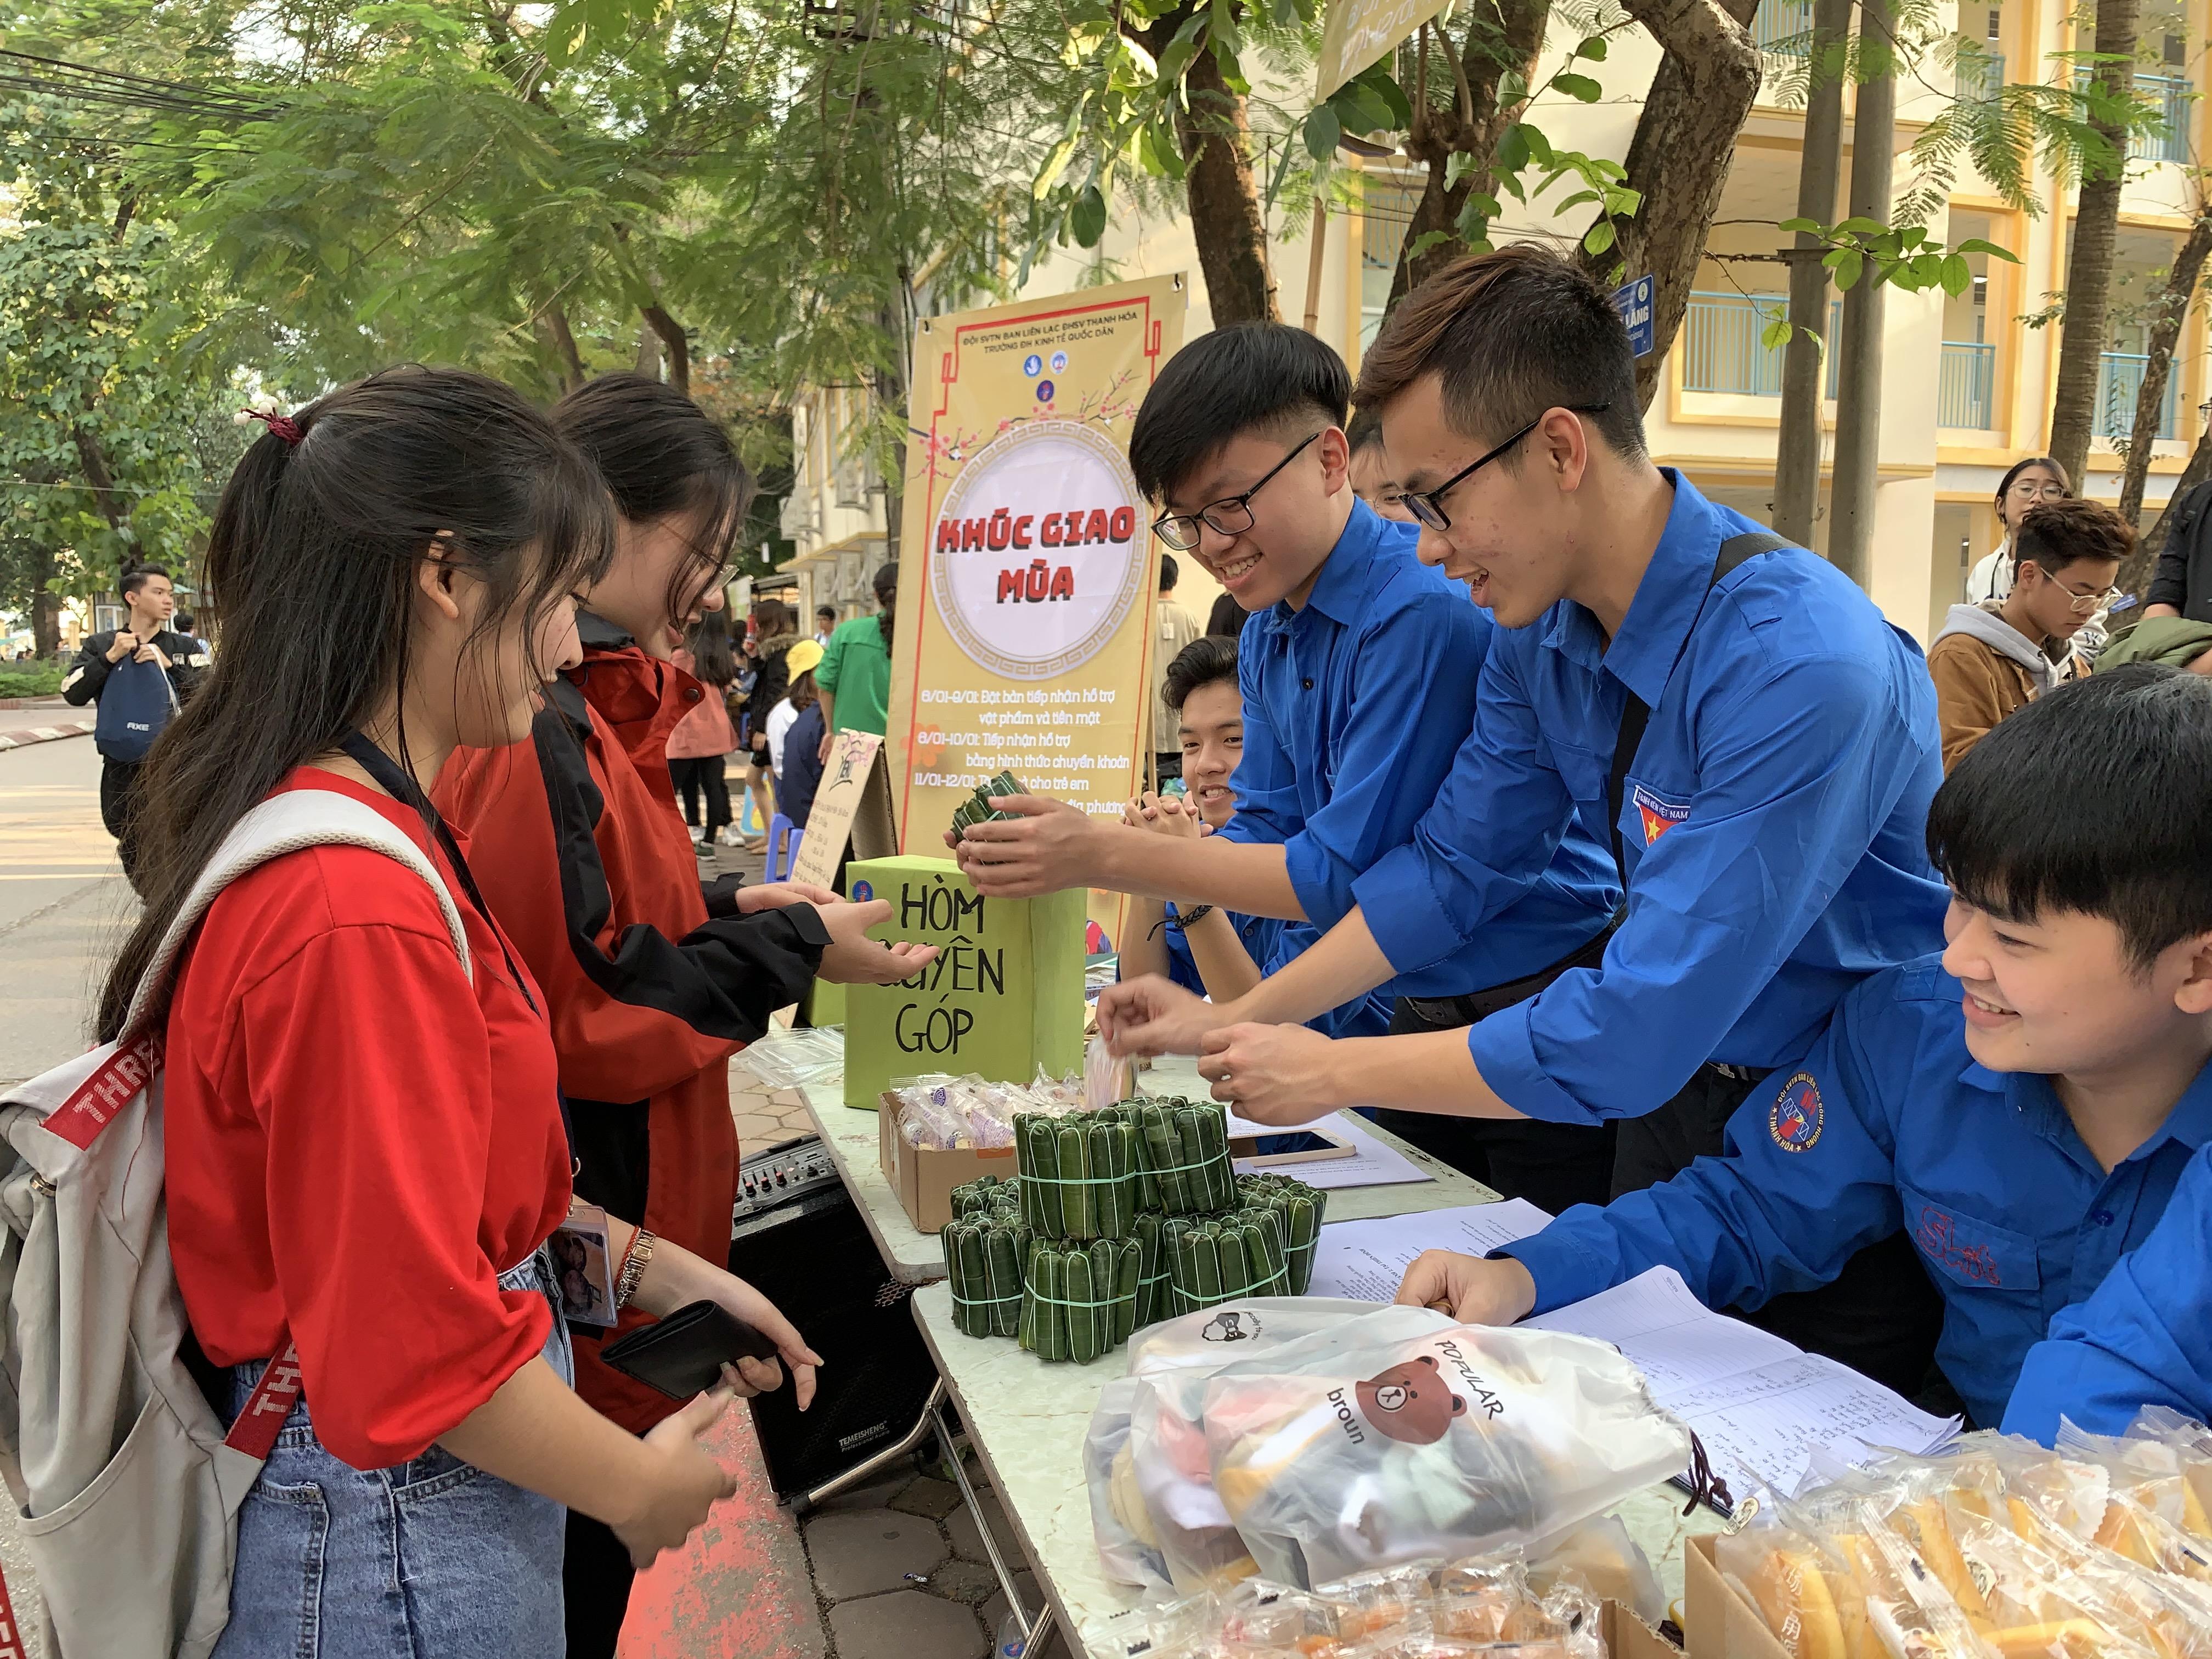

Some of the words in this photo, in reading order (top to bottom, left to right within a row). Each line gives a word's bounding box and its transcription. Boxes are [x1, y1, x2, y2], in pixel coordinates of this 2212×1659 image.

[980, 334, 1001, 343] SVTN
[1003, 330, 1020, 340] BAN
[1023, 326, 1041, 337] LIÊN
[1087, 315, 1116, 326] THANH
[1034, 336, 1054, 347] KINH
[936, 507, 1034, 554] KHÚC
[1041, 505, 1136, 549] GIAO
[996, 558, 1075, 604] MÙA
[1027, 689, 1048, 706] tiếp
[1050, 689, 1080, 704] nhận
[1099, 689, 1116, 704] trợ
[1036, 710, 1050, 725] và
[126, 721, 149, 732] AXE
[1006, 732, 1036, 748] nhận
[1056, 733, 1071, 748] trợ
[997, 753, 1023, 768] hình
[1024, 754, 1051, 768] thức
[1030, 775, 1052, 789] cho
[1070, 779, 1090, 791] em
[1669, 810, 1689, 819] NAM
[901, 874, 985, 934] HÒM
[895, 992, 974, 1055] GÓP
[1770, 1115, 1783, 1143] THANH
[1434, 1340, 1504, 1420] POPULAR
[839, 1422, 885, 1447] TEMEISHENG
[875, 1430, 890, 1439] Audio
